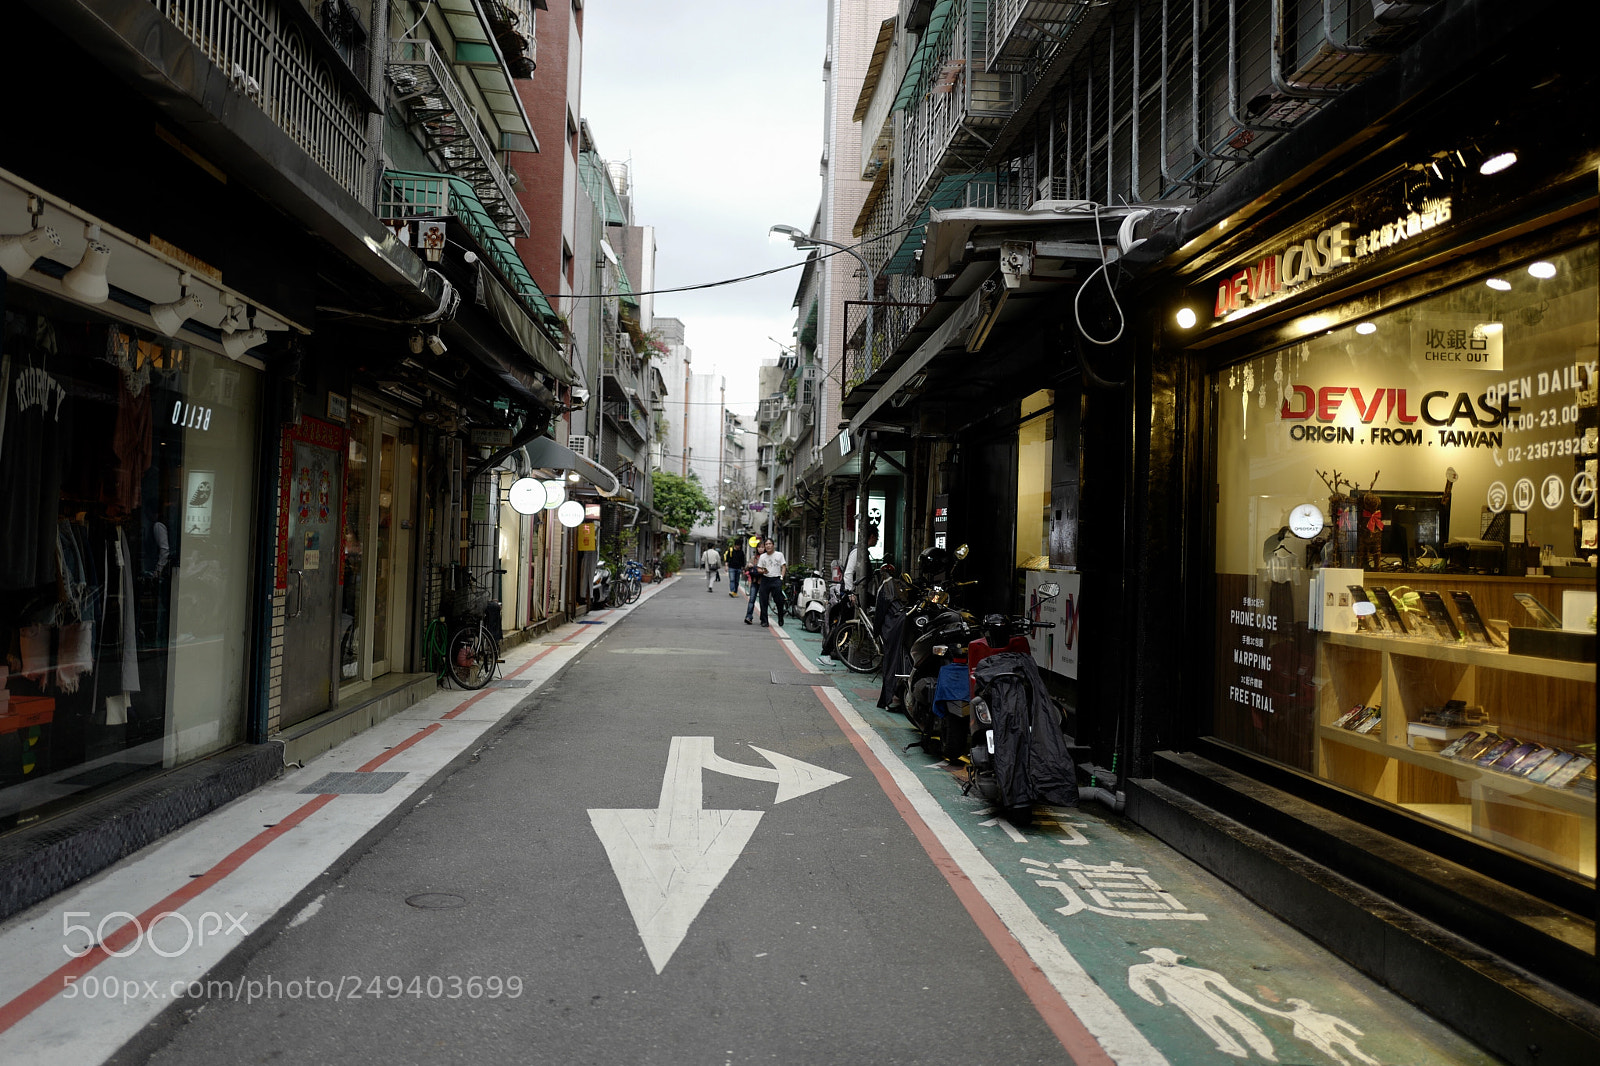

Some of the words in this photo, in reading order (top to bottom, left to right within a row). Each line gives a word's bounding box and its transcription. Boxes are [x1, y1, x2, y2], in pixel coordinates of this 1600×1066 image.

[1425, 328, 1489, 351] 收銀台
[1425, 351, 1462, 362] CHECK
[1466, 352, 1490, 363] OUT
[1486, 376, 1532, 407] OPEN
[1537, 361, 1597, 396] DAILY
[1290, 424, 1355, 446] ORIGIN
[1371, 426, 1423, 447] FROM
[1438, 430, 1503, 449] TAIWAN
[1230, 609, 1255, 627] PHONE
[1256, 613, 1278, 631] CASE
[1233, 648, 1272, 672] WARPPING
[1229, 686, 1249, 705] FREE
[1250, 692, 1275, 714] TRIAL
